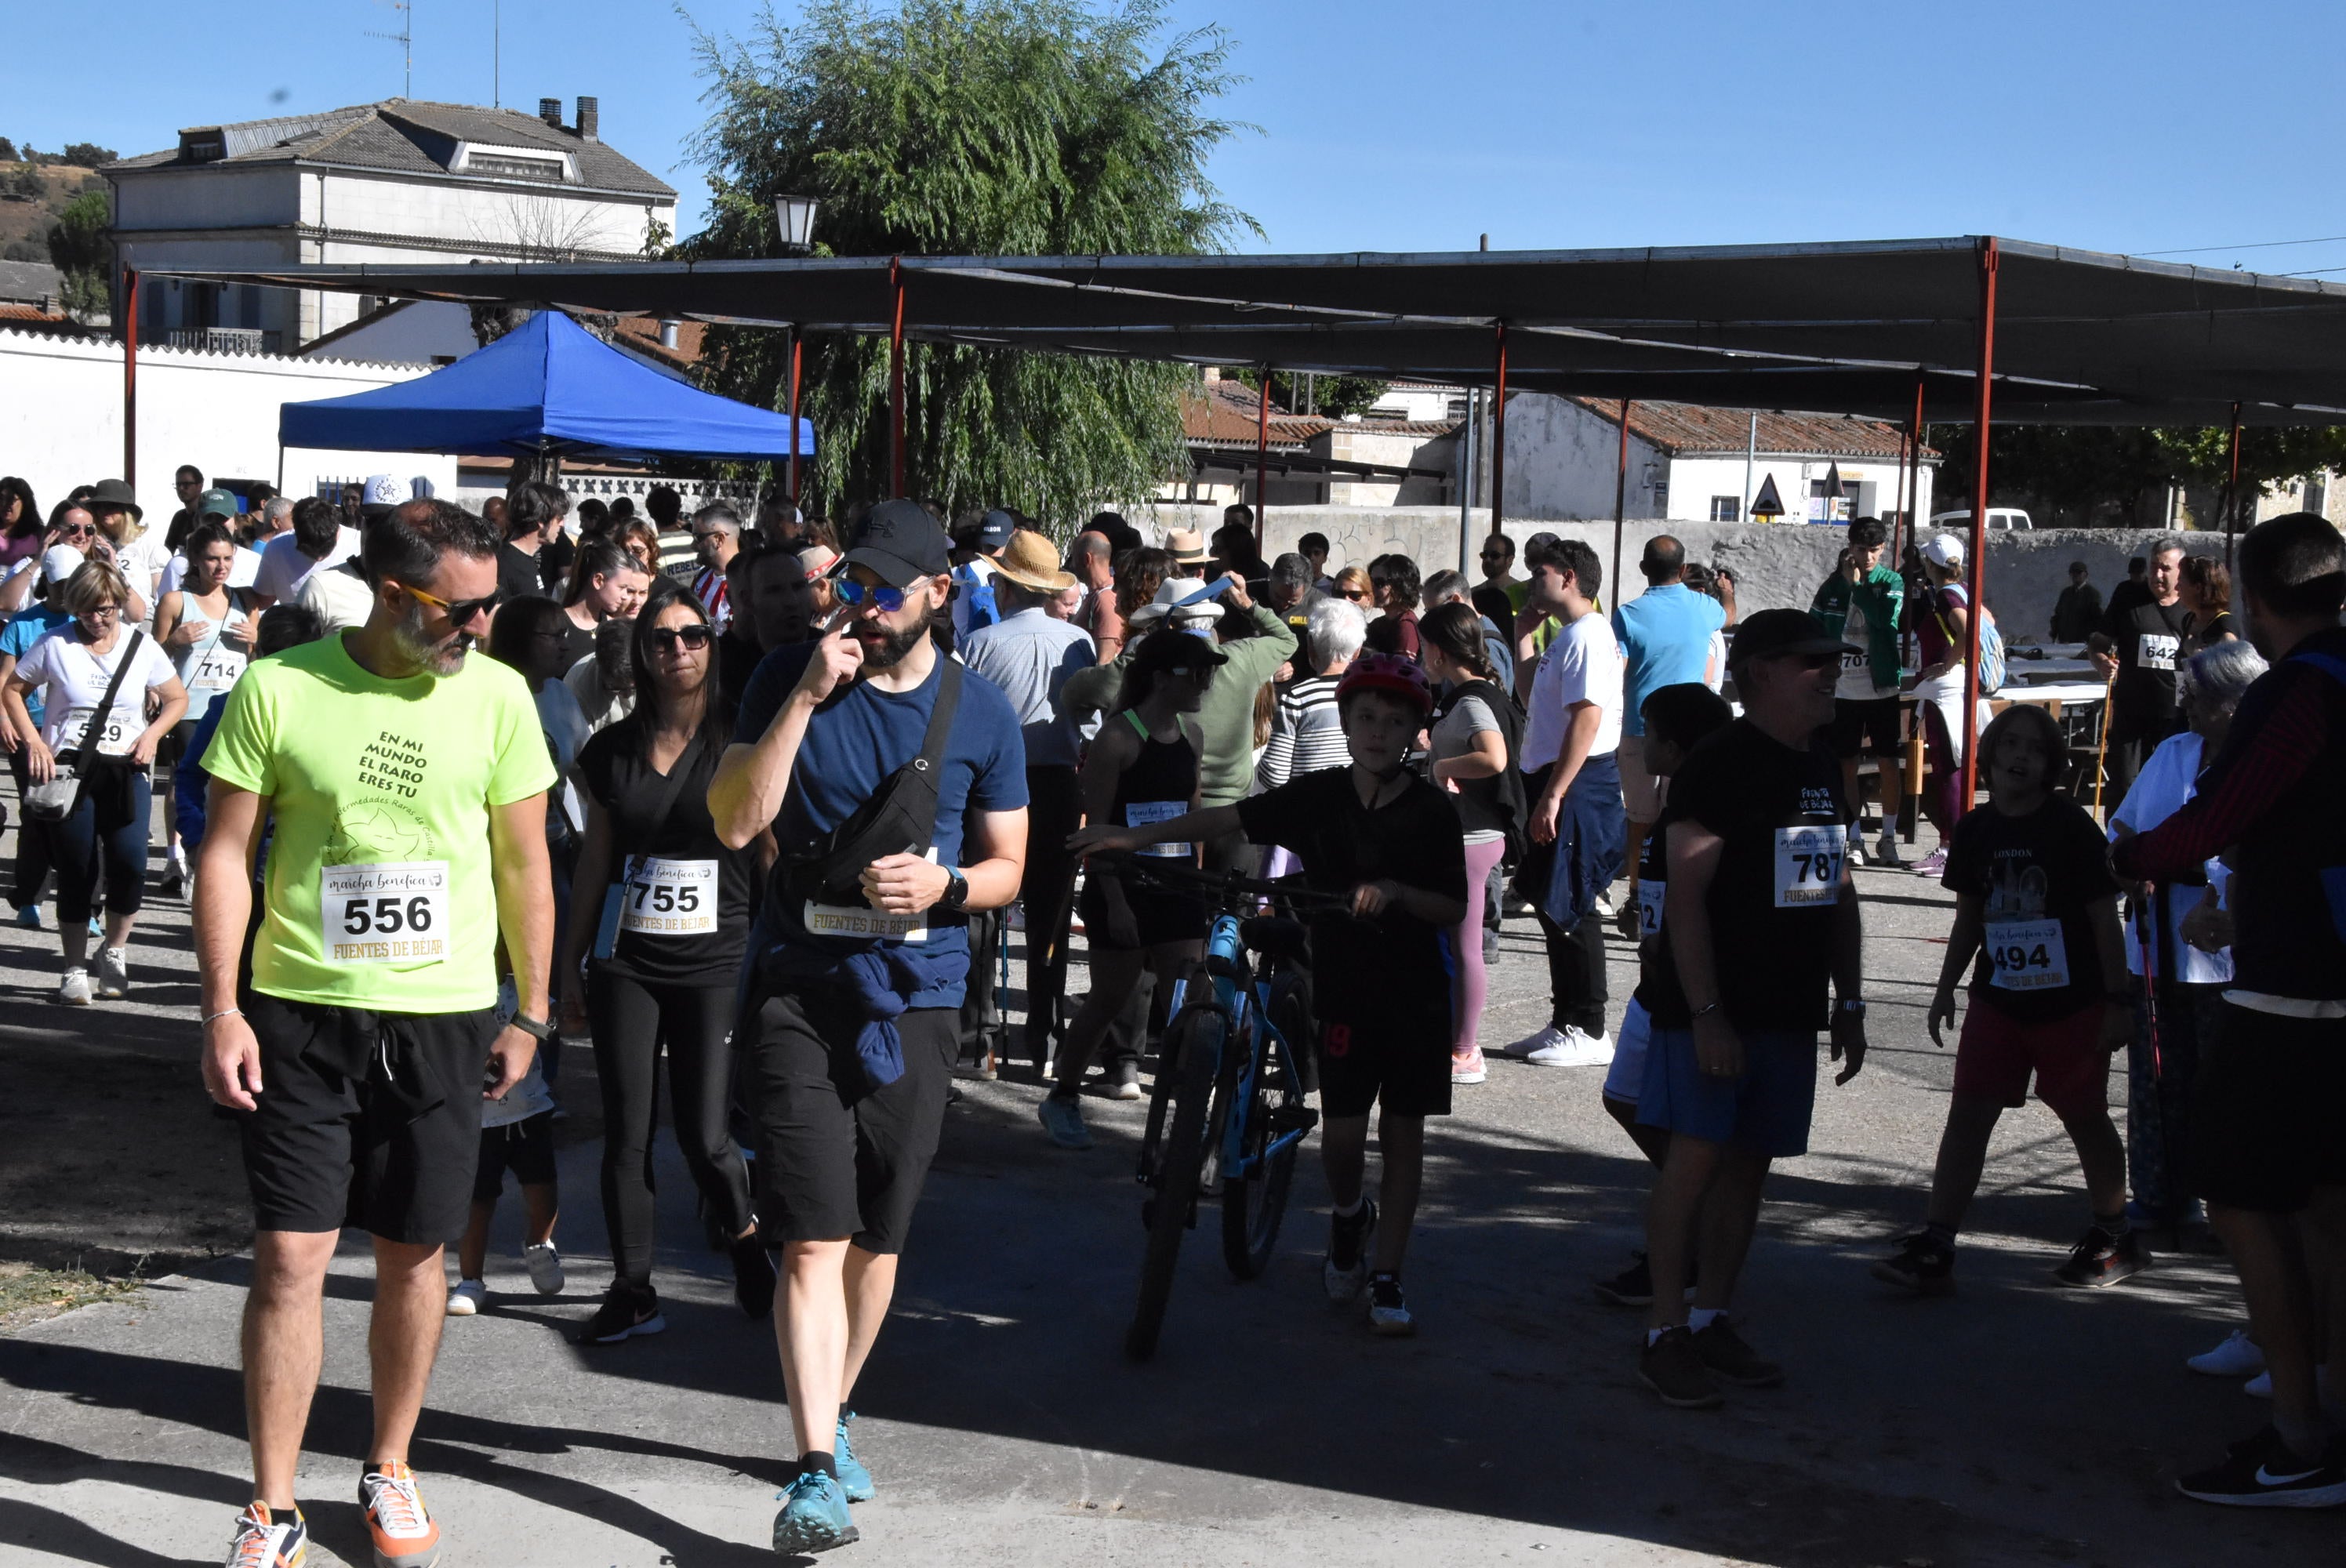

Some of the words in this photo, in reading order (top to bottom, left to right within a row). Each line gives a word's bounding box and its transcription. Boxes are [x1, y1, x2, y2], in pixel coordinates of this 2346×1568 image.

[2145, 646, 2177, 659] 642
[202, 662, 235, 679] 714
[77, 723, 122, 742] 59
[380, 731, 401, 745] EN
[402, 739, 423, 753] MI
[365, 743, 427, 768] MUNDO
[358, 756, 375, 769] EL
[379, 762, 423, 783] RARO
[358, 771, 394, 791] ERES
[397, 784, 418, 798] TU
[392, 799, 416, 816] Raras
[415, 815, 424, 826] de
[1994, 848, 2032, 859] LONDON
[1792, 852, 1841, 883] 787
[329, 874, 374, 892] marcha
[633, 881, 699, 913] 755
[1784, 889, 1825, 902] FUENTES
[343, 896, 431, 935] 556
[665, 918, 678, 930] DE
[814, 913, 867, 932] FUENTES
[870, 919, 887, 934] DE
[333, 942, 389, 960] FUENTES
[393, 941, 409, 956] DE
[1995, 943, 2050, 971] 494
